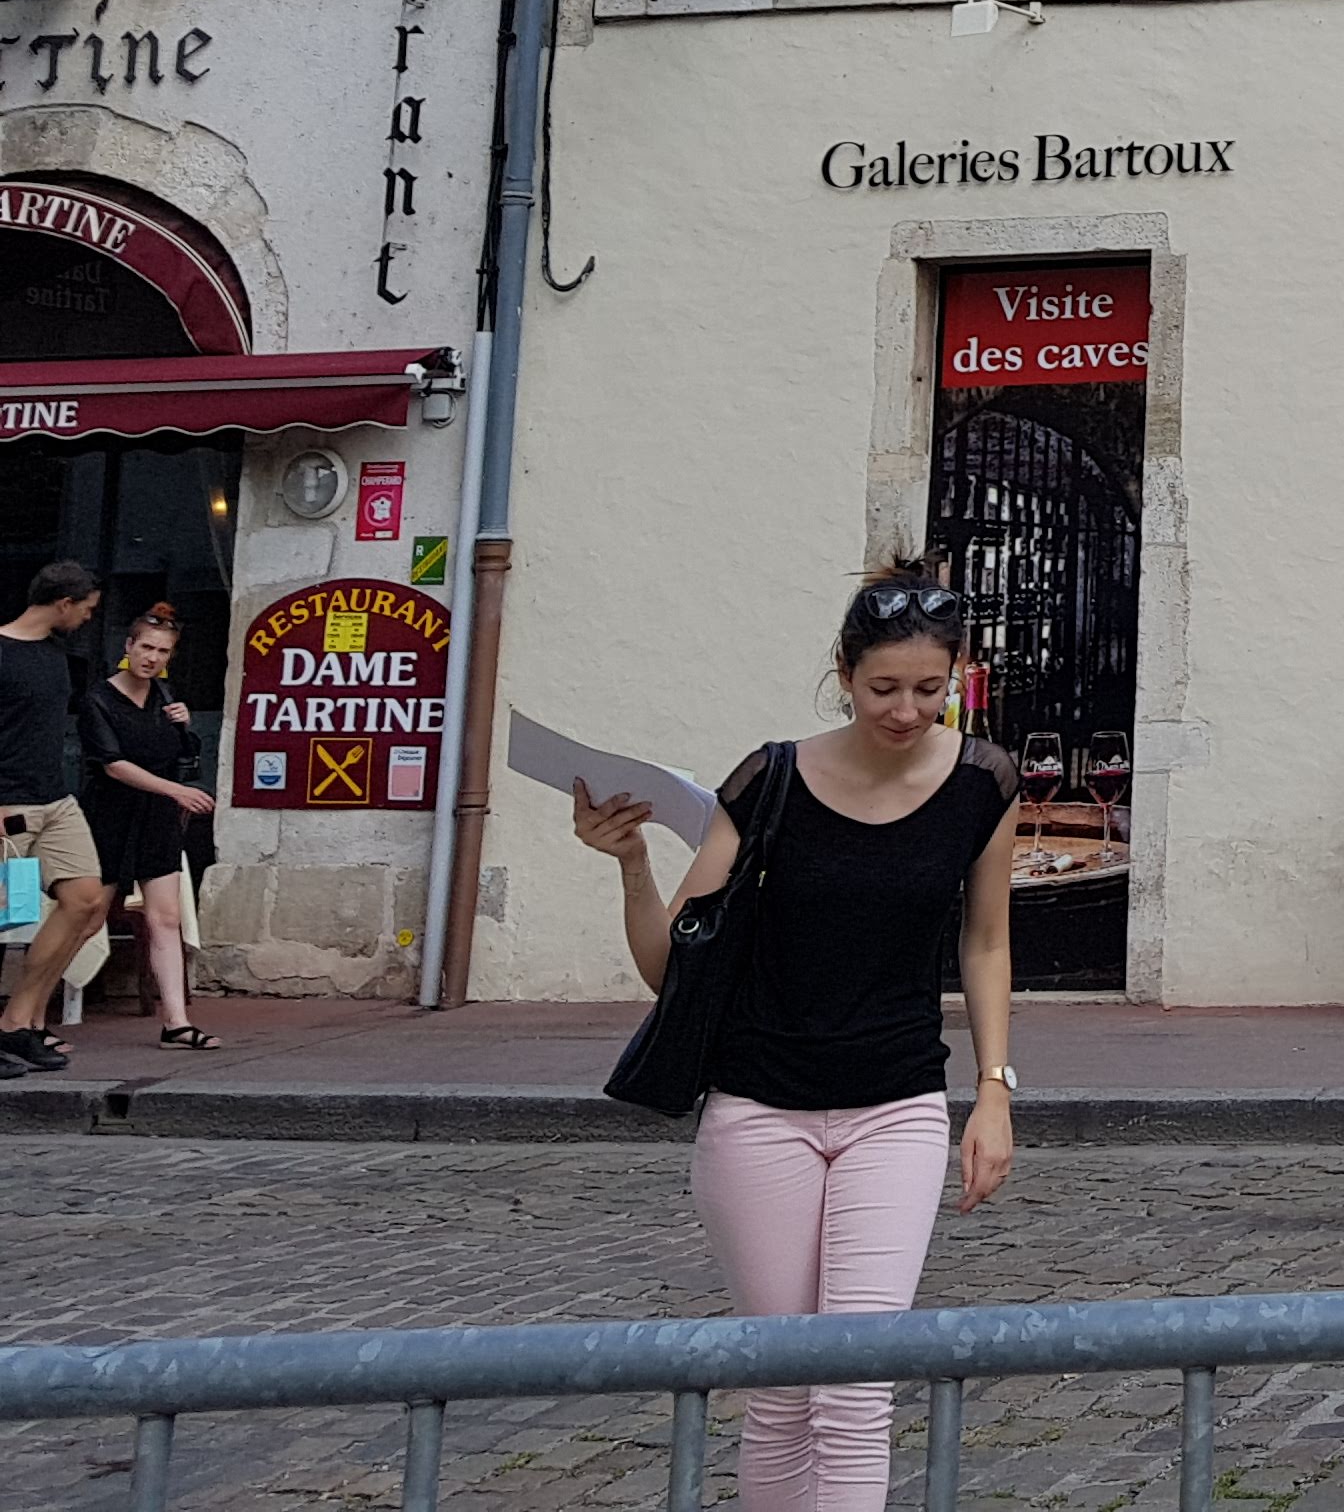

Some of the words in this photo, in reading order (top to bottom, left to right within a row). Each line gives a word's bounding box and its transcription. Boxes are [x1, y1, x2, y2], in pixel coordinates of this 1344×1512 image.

[821, 139, 1020, 189] Galeries
[1032, 133, 1236, 182] Bartoux
[993, 284, 1114, 322] Visite
[952, 336, 1024, 373] des
[1037, 339, 1150, 370] caves
[415, 544, 424, 557] R
[280, 648, 418, 687] DAME
[247, 693, 446, 732] TARTINE
